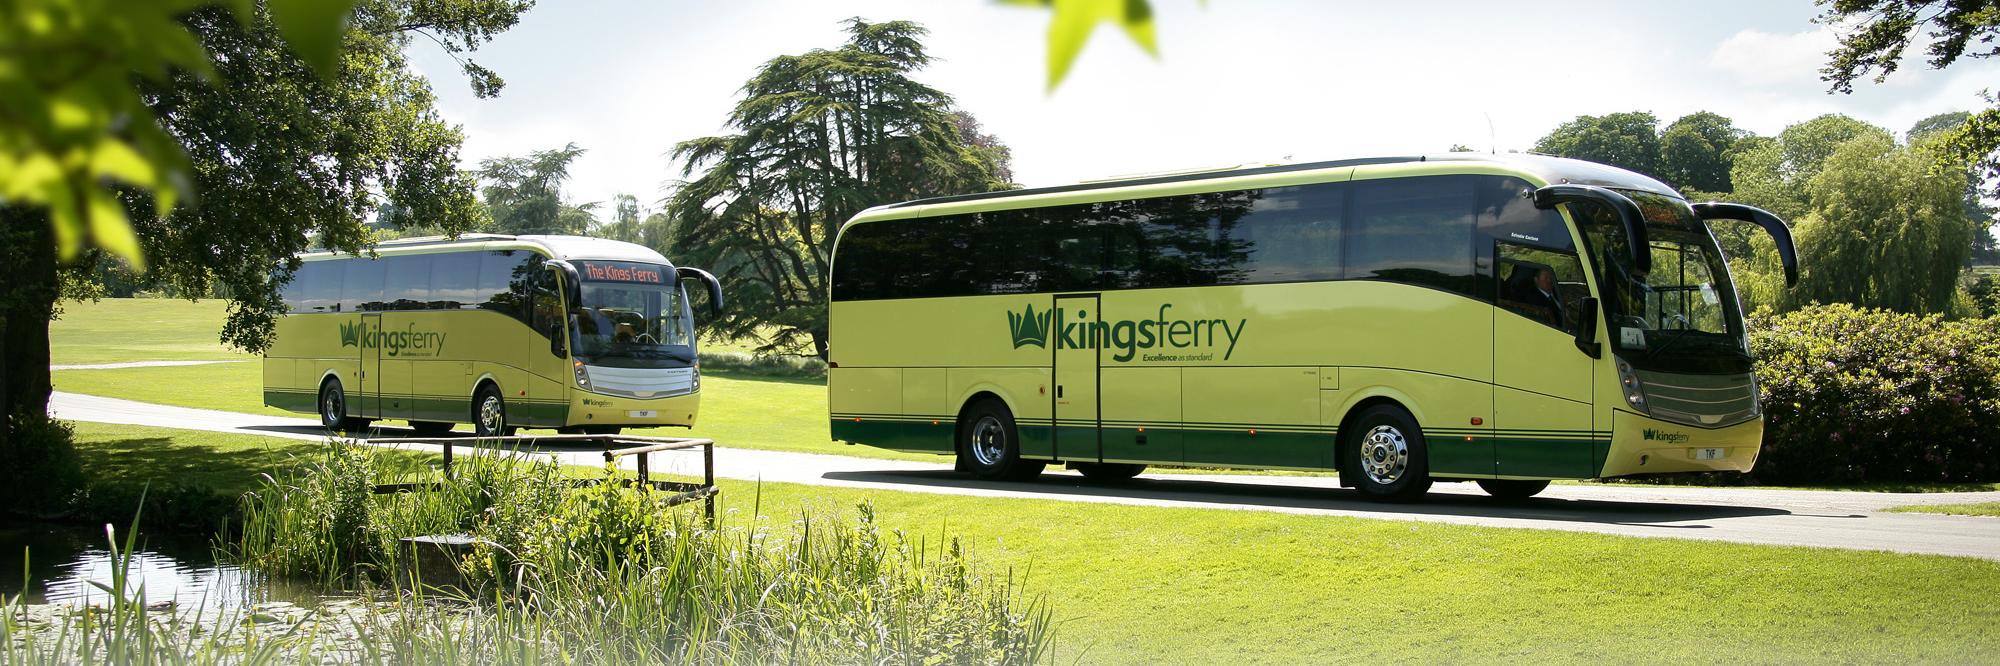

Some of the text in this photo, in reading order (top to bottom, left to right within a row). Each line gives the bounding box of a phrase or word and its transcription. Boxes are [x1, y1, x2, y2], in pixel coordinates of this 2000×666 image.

[584, 263, 659, 283] The Kings Ferry
[363, 321, 447, 357] kingsferry
[1057, 303, 1247, 362] kingsferry
[1143, 353, 1177, 361] Excellence
[1186, 353, 1213, 361] standard
[1656, 429, 1689, 444] kingsferry
